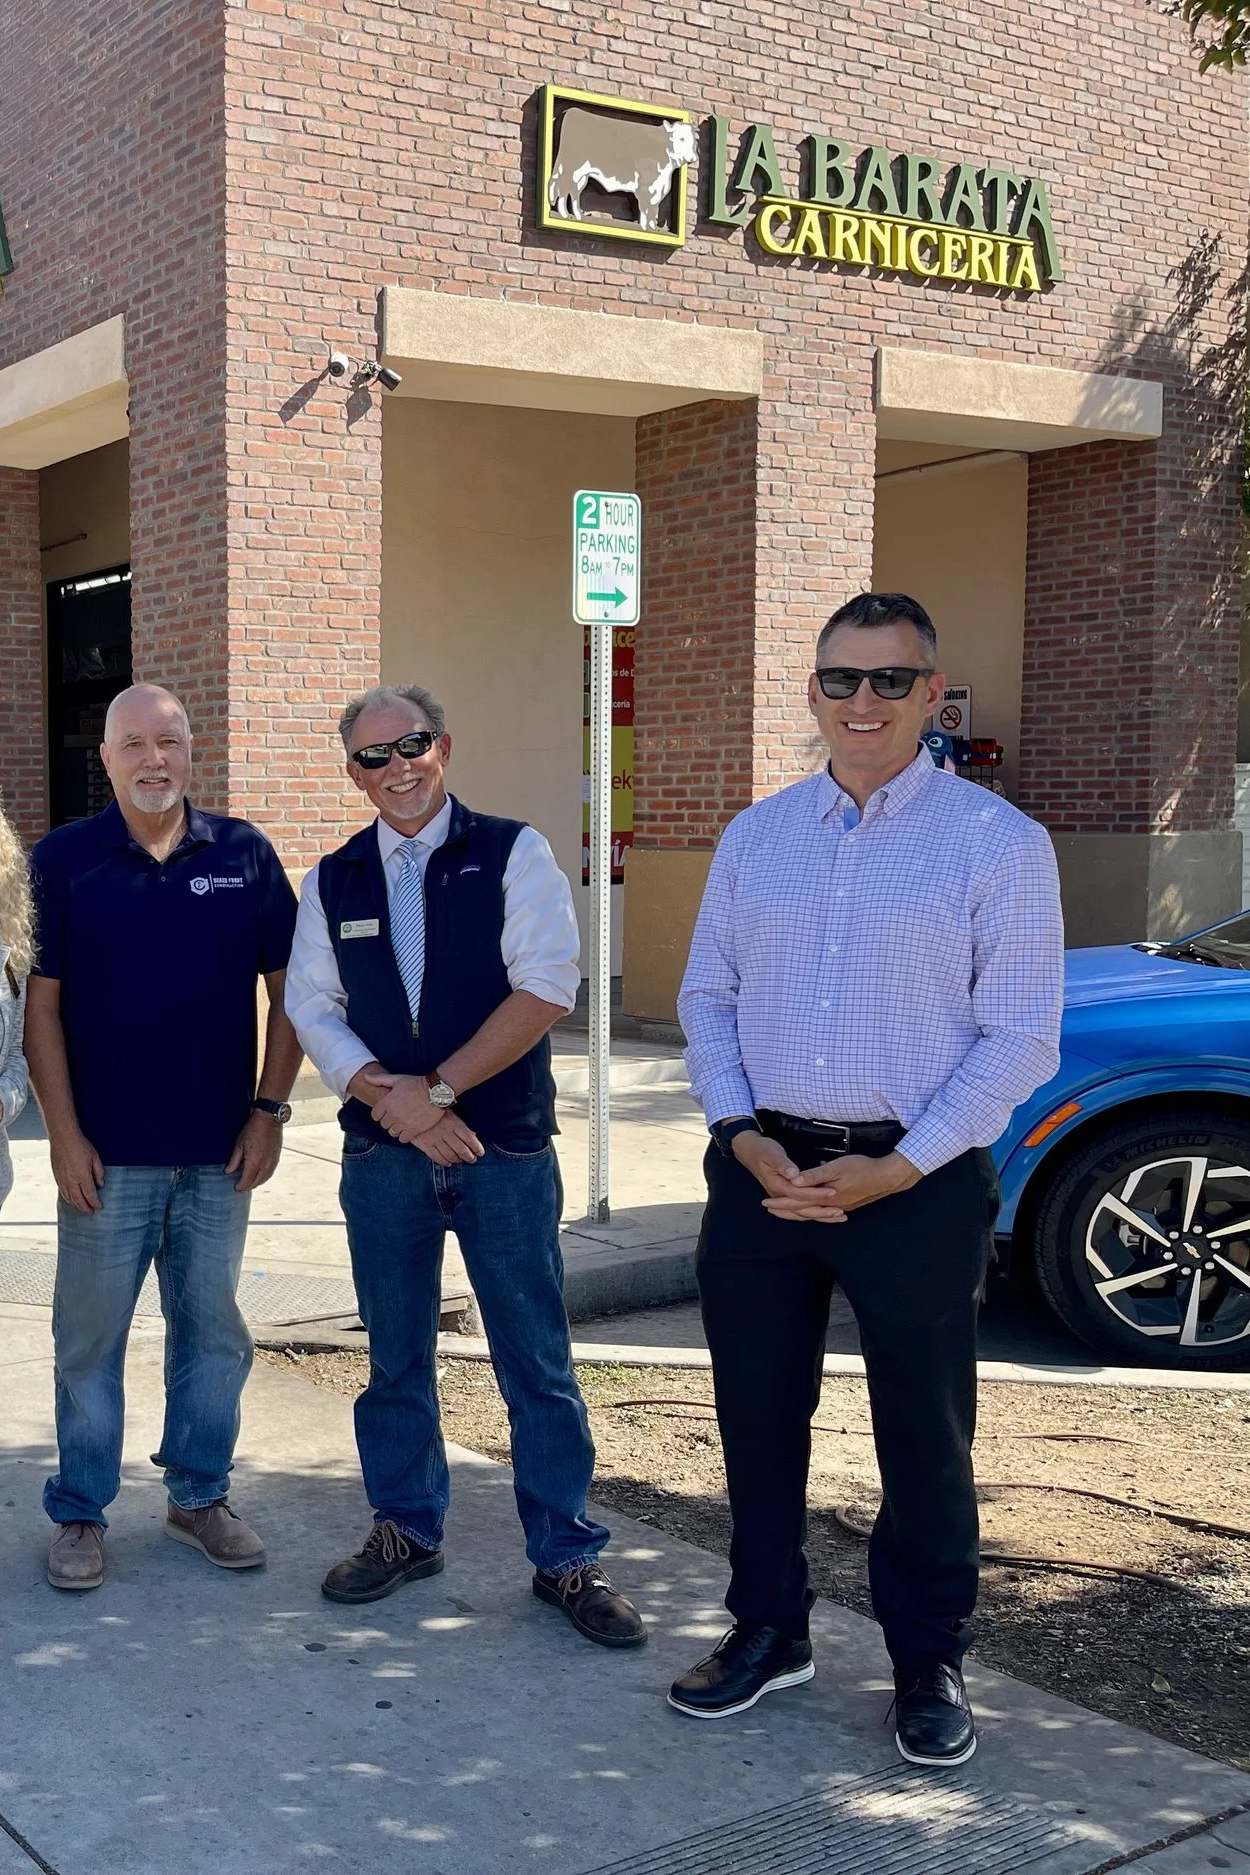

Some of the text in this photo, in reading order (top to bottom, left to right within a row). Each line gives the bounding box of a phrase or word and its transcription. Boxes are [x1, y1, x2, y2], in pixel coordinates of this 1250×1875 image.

[707, 114, 1065, 282] LA BARATA
[754, 203, 1044, 293] CARNICERIA
[581, 496, 634, 526] 2 HOUR
[579, 532, 635, 554] PARKING
[581, 555, 602, 575] 8AM
[613, 557, 634, 577] 7PM
[944, 689, 967, 700] SMOKING
[1124, 1134, 1208, 1157] MICHELIN
